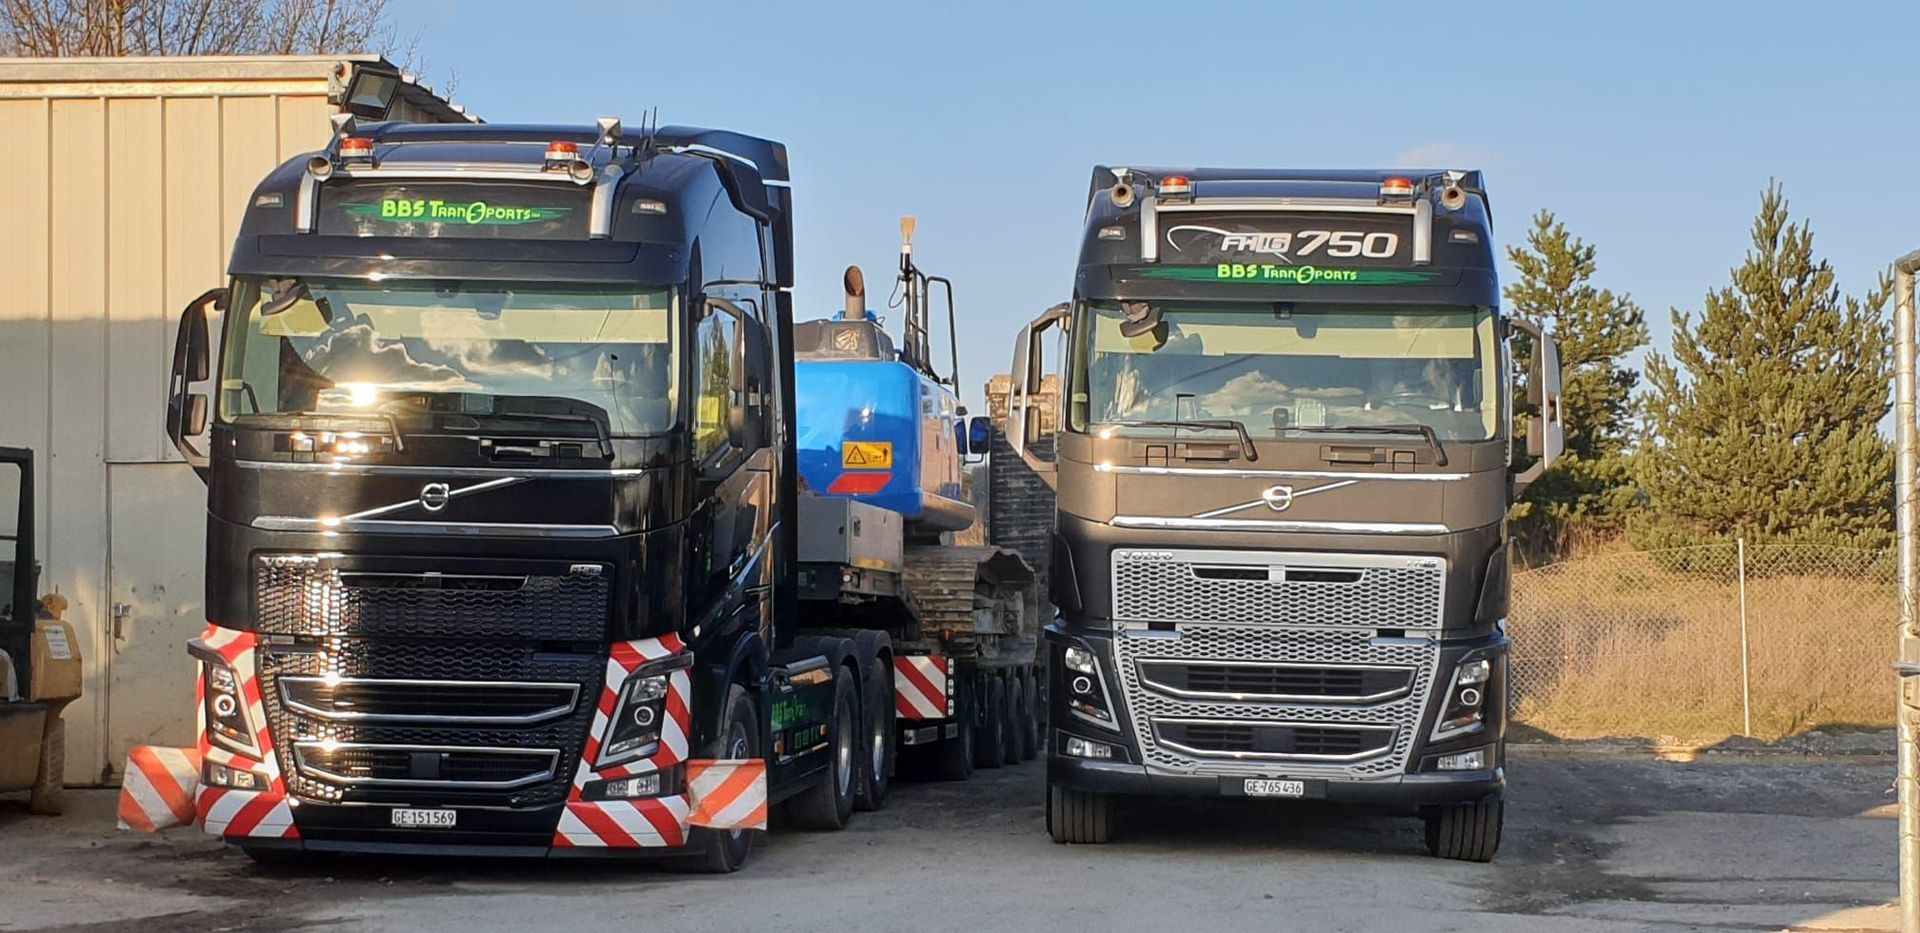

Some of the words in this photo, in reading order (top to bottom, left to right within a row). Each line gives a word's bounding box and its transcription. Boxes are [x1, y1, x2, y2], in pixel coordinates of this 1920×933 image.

[382, 200, 425, 217] BBS
[1296, 231, 1399, 258] 750
[1217, 264, 1257, 279] BBS
[1120, 551, 1173, 560] VOLVO
